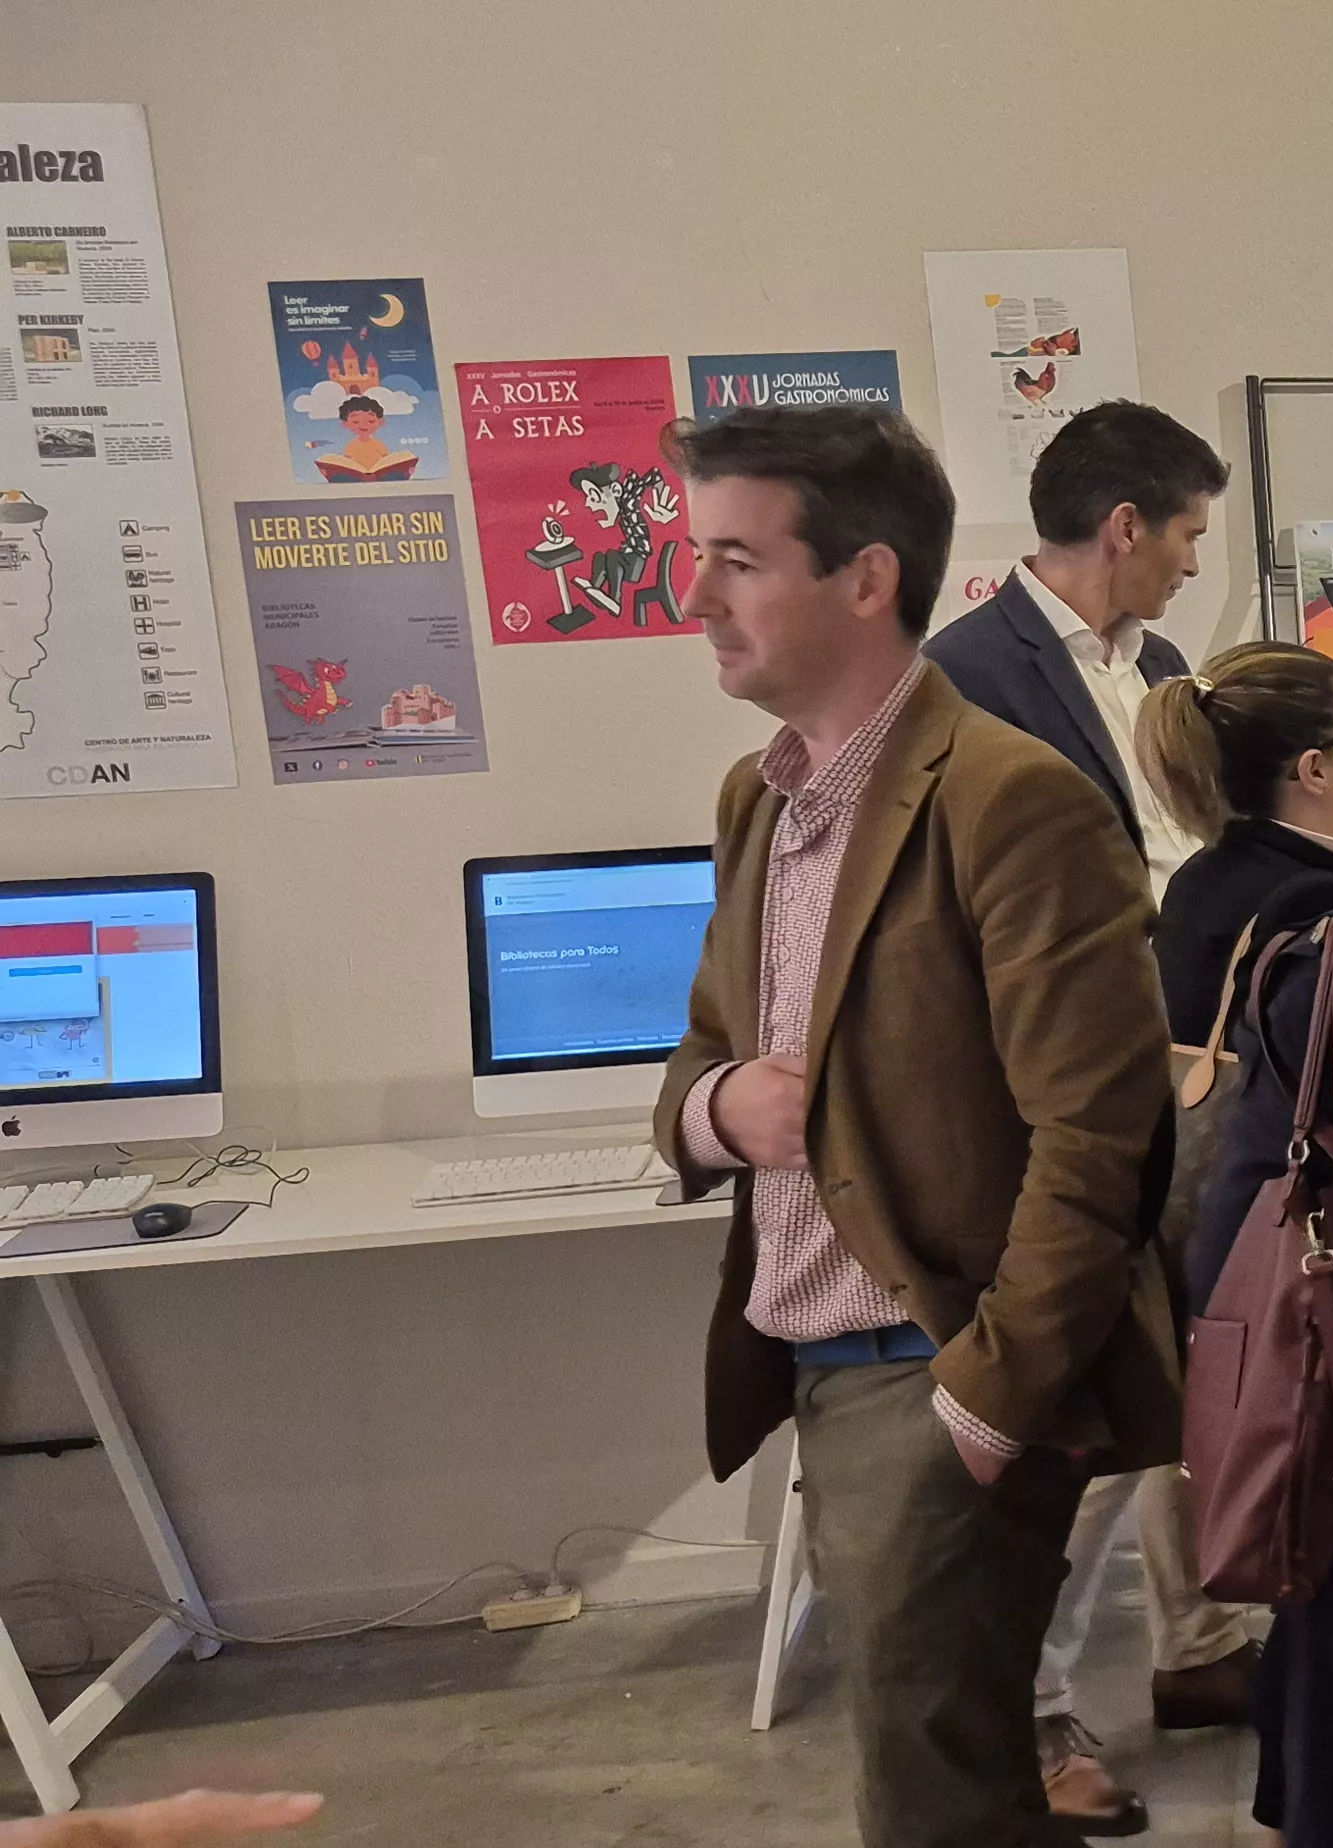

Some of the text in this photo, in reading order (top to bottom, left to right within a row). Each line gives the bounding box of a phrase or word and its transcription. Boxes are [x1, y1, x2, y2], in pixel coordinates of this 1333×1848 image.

[0, 144, 104, 183] aleza
[6, 226, 107, 238] ALBERTO CARNEIRO
[284, 295, 308, 305] Leer
[286, 304, 350, 315] es imaginar
[18, 315, 39, 326] PER
[287, 317, 303, 326] sin
[772, 372, 841, 388] JORNADAS
[471, 381, 580, 405] A ROLEX
[774, 386, 890, 405] GASTRONÓMICAS
[32, 405, 109, 418] RICHARD LONG
[476, 415, 585, 440] A SETAS
[250, 511, 445, 542] LEER ES VIAJAR SIN
[254, 539, 449, 570] MOVERTE DEL SITIO
[964, 576, 999, 601] GA
[85, 738, 117, 747] CENTRO
[119, 737, 129, 745] DE
[131, 736, 152, 745] ARTE
[160, 734, 212, 743] NATURALEZA
[46, 762, 131, 786] CDAN
[500, 944, 620, 962] Bibliotecas para Todos
